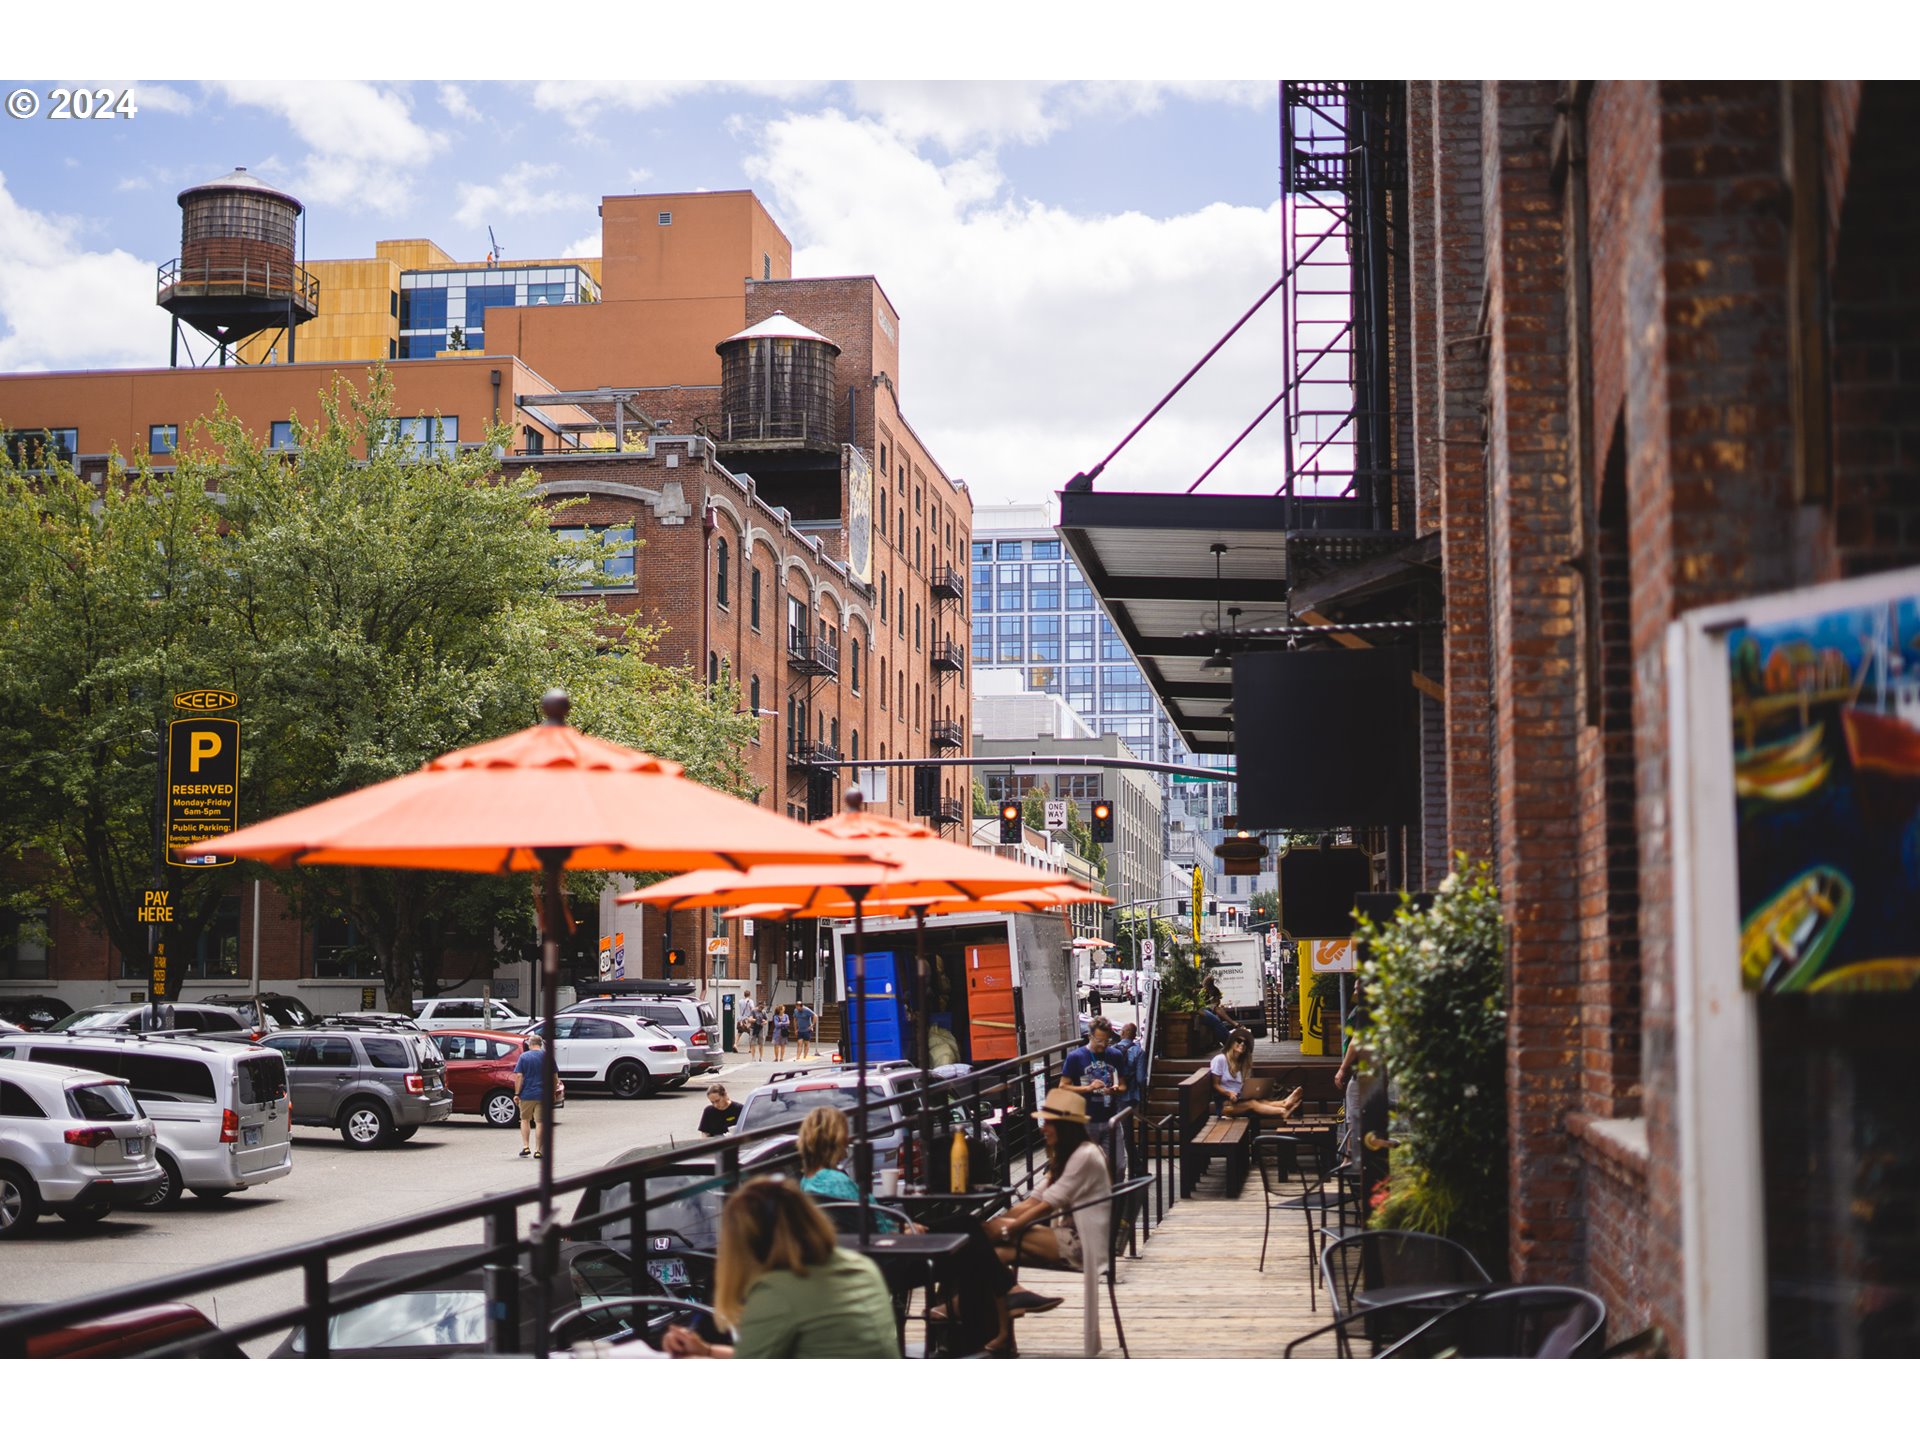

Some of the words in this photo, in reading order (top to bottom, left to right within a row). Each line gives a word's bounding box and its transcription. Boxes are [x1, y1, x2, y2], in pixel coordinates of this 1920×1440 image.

[177, 693, 234, 708] KEEN
[190, 731, 222, 772] P
[172, 784, 233, 795] RESERVED
[173, 798, 231, 807] Monday-Friday
[183, 808, 221, 816] 6am-5pm
[172, 824, 197, 832] Public
[198, 824, 231, 833] Parking:
[144, 891, 169, 906] PAY
[138, 907, 174, 922] HERE
